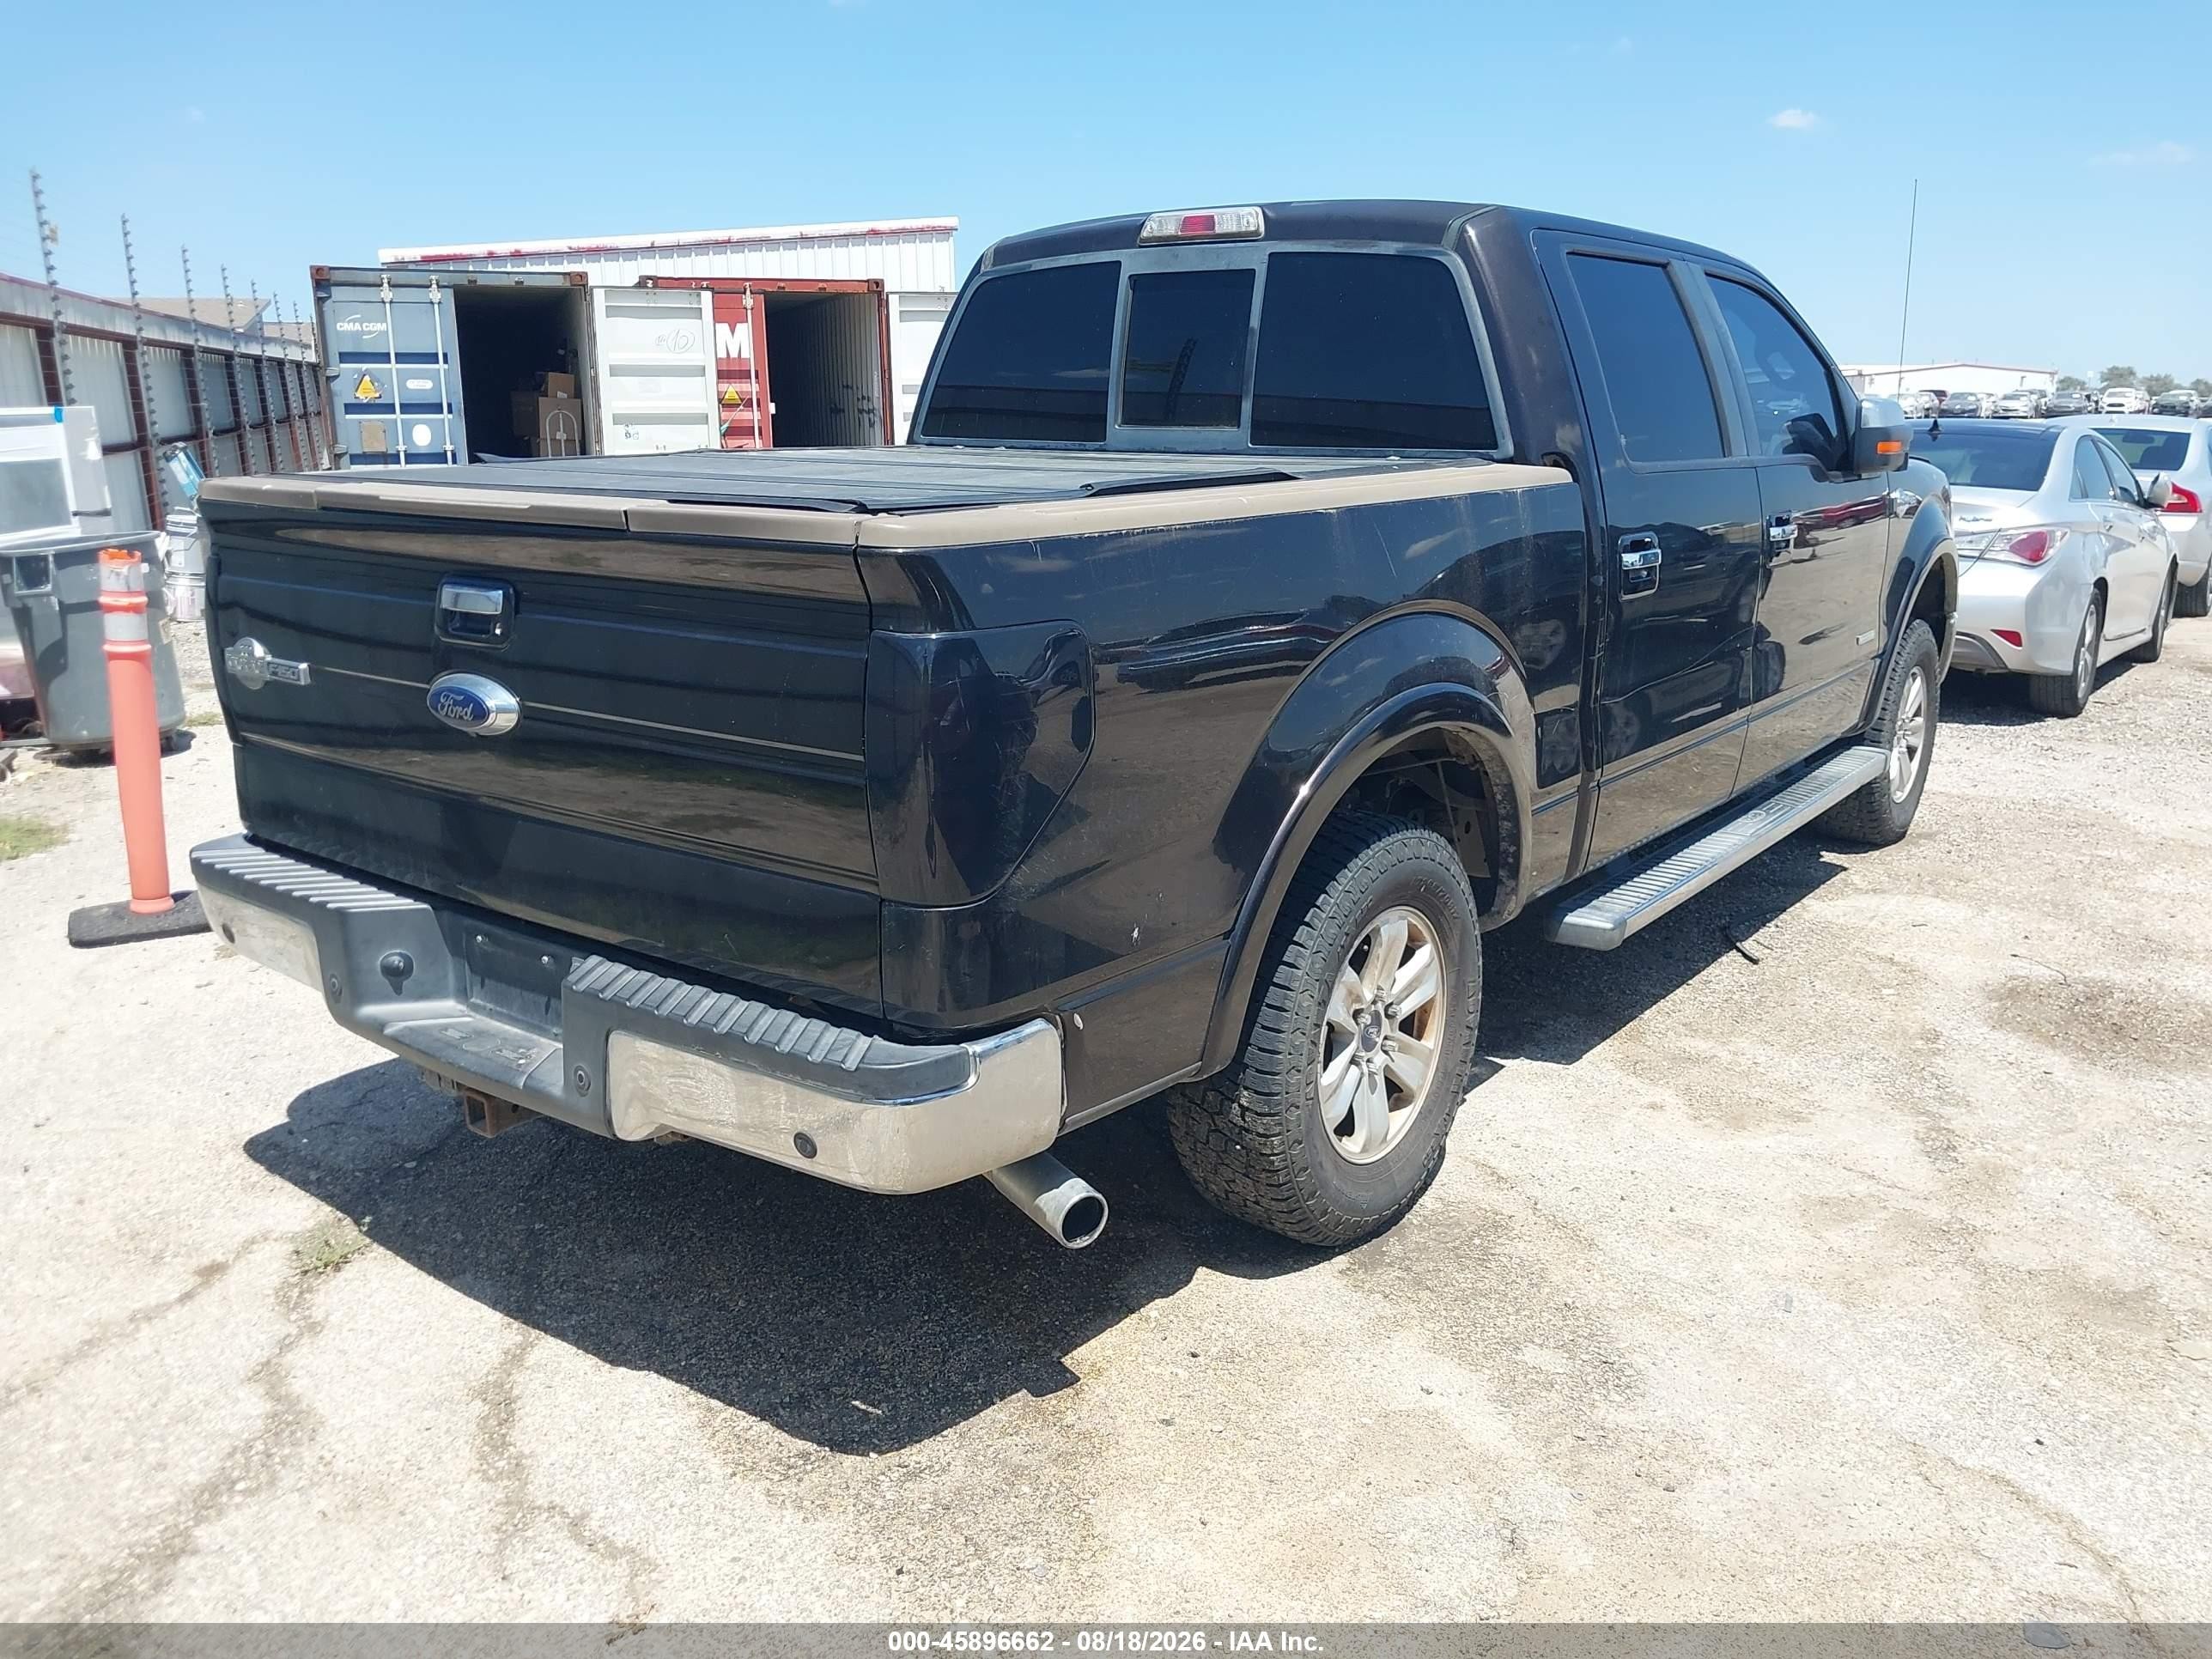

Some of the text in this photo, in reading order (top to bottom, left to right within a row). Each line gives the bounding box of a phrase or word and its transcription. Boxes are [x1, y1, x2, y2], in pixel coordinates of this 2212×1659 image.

[336, 322, 387, 331] CMA CGM
[438, 691, 474, 721] Ford
